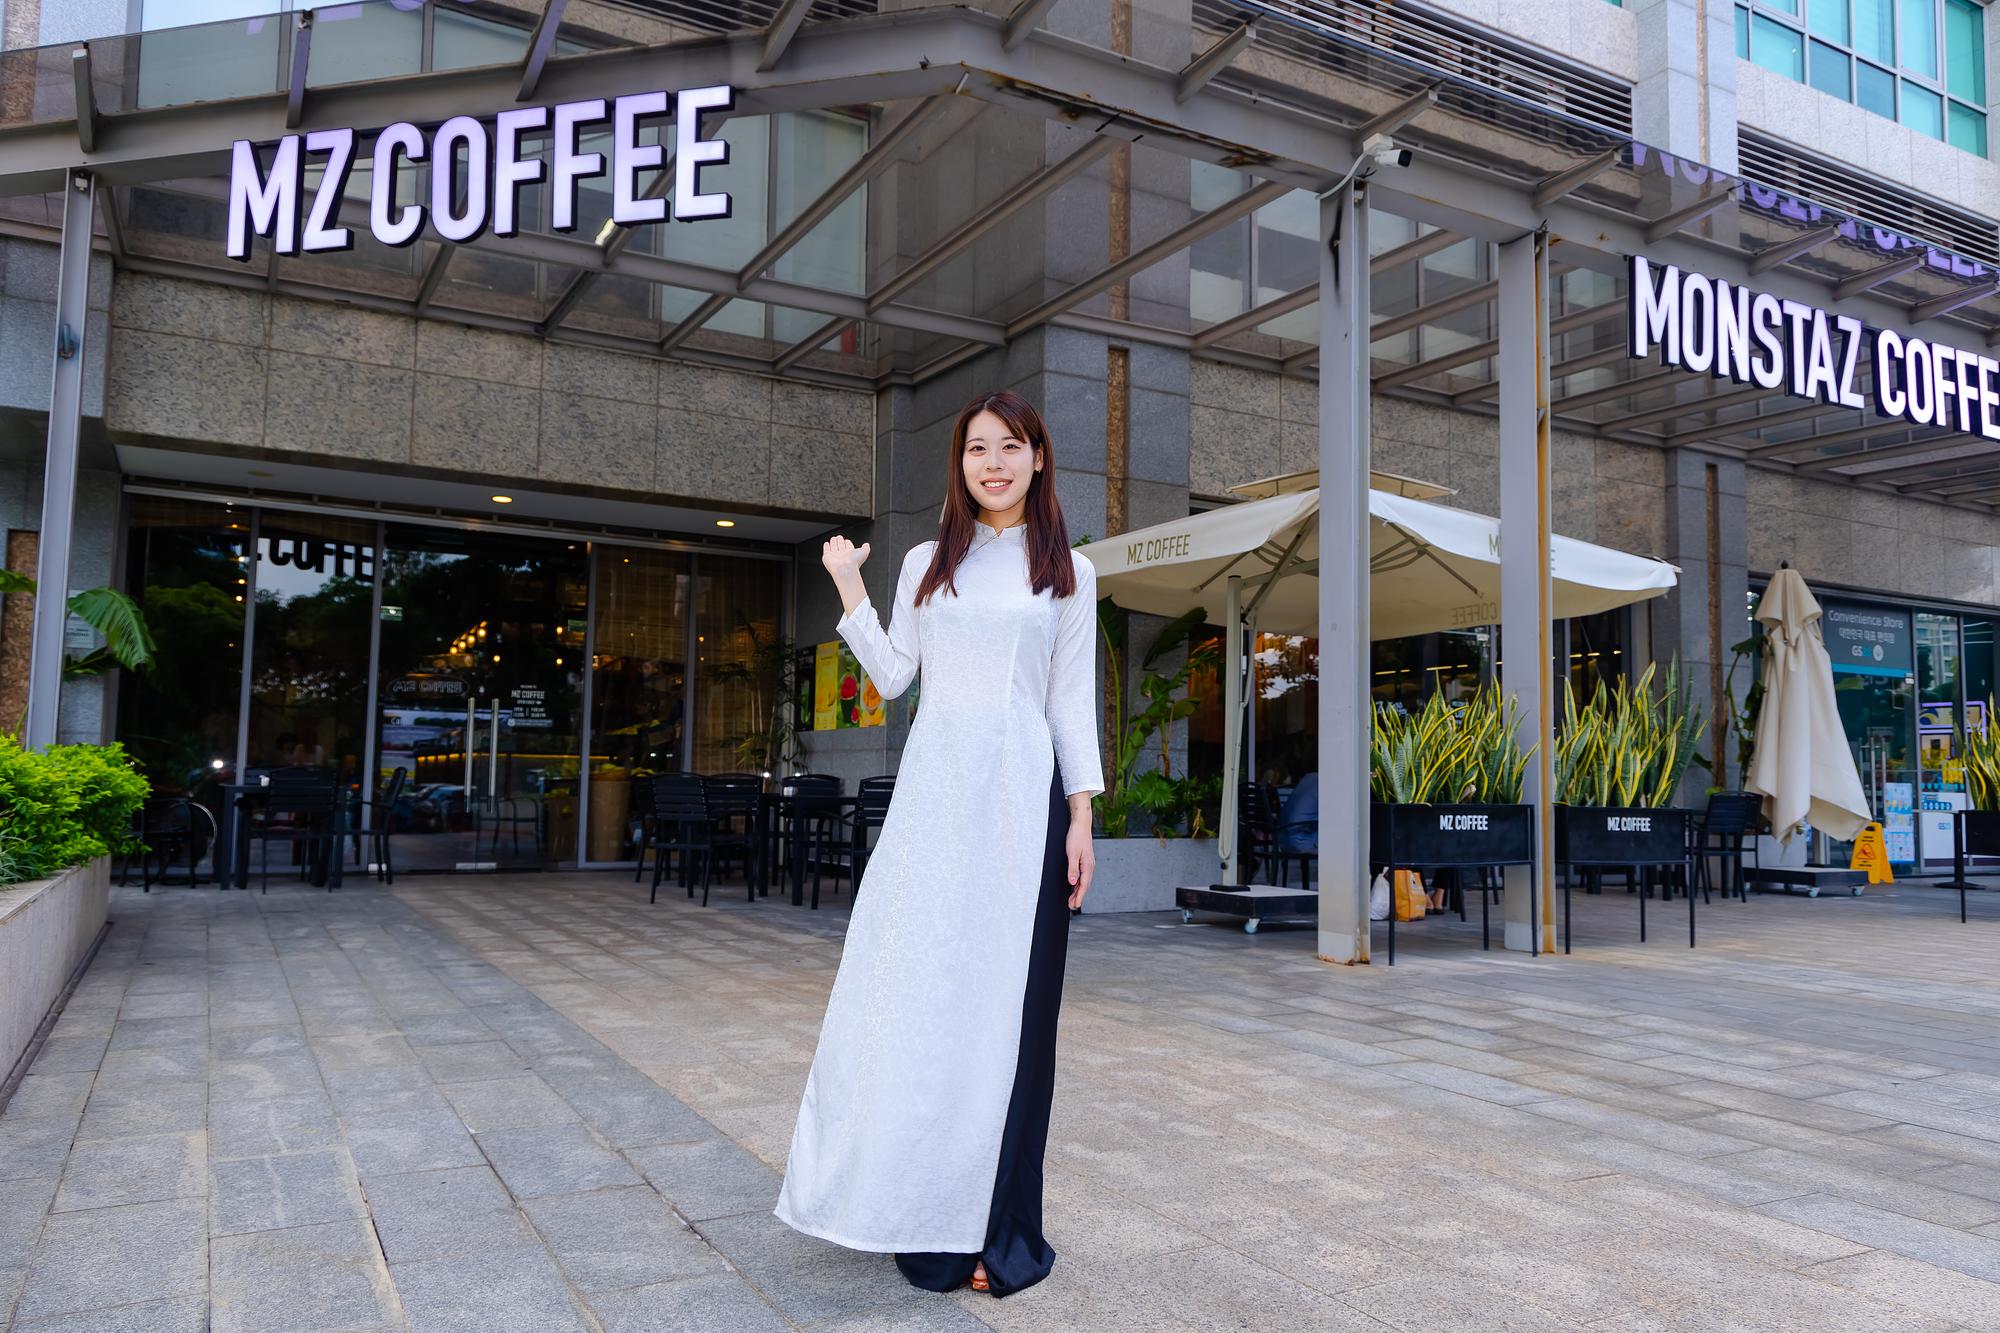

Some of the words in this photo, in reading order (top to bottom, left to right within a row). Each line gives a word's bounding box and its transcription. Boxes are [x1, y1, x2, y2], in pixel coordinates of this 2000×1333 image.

[226, 127, 354, 261] MZ
[369, 85, 735, 247] COFFEE
[1628, 255, 1865, 409] MONSTAZ
[1871, 329, 2000, 441] COFFE
[1127, 543, 1143, 566] MZ
[1146, 534, 1191, 561] COFFEE
[1489, 533, 1500, 557] M
[1828, 609, 1882, 626] Convenience
[1883, 616, 1904, 629] Store
[522, 690, 545, 700] COFFEE
[1439, 814, 1453, 831] MZ
[1455, 815, 1488, 831] COFFEE
[1607, 816, 1620, 831] MZ
[1621, 817, 1650, 831] COFFEE
